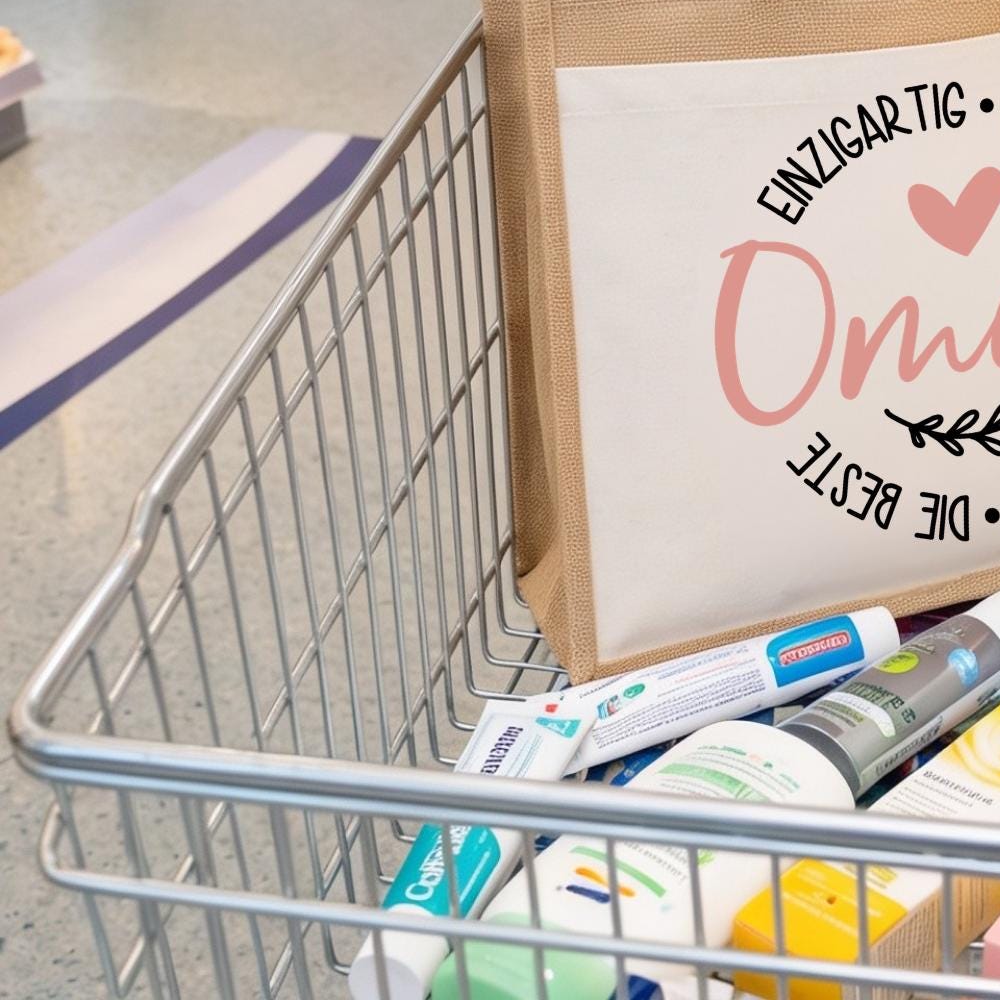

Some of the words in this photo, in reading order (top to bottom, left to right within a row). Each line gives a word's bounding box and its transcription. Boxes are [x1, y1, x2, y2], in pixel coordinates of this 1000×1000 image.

[756, 81, 967, 225] EINZIGARTIG
[785, 431, 903, 530] BESTE
[914, 491, 970, 542] DIE
